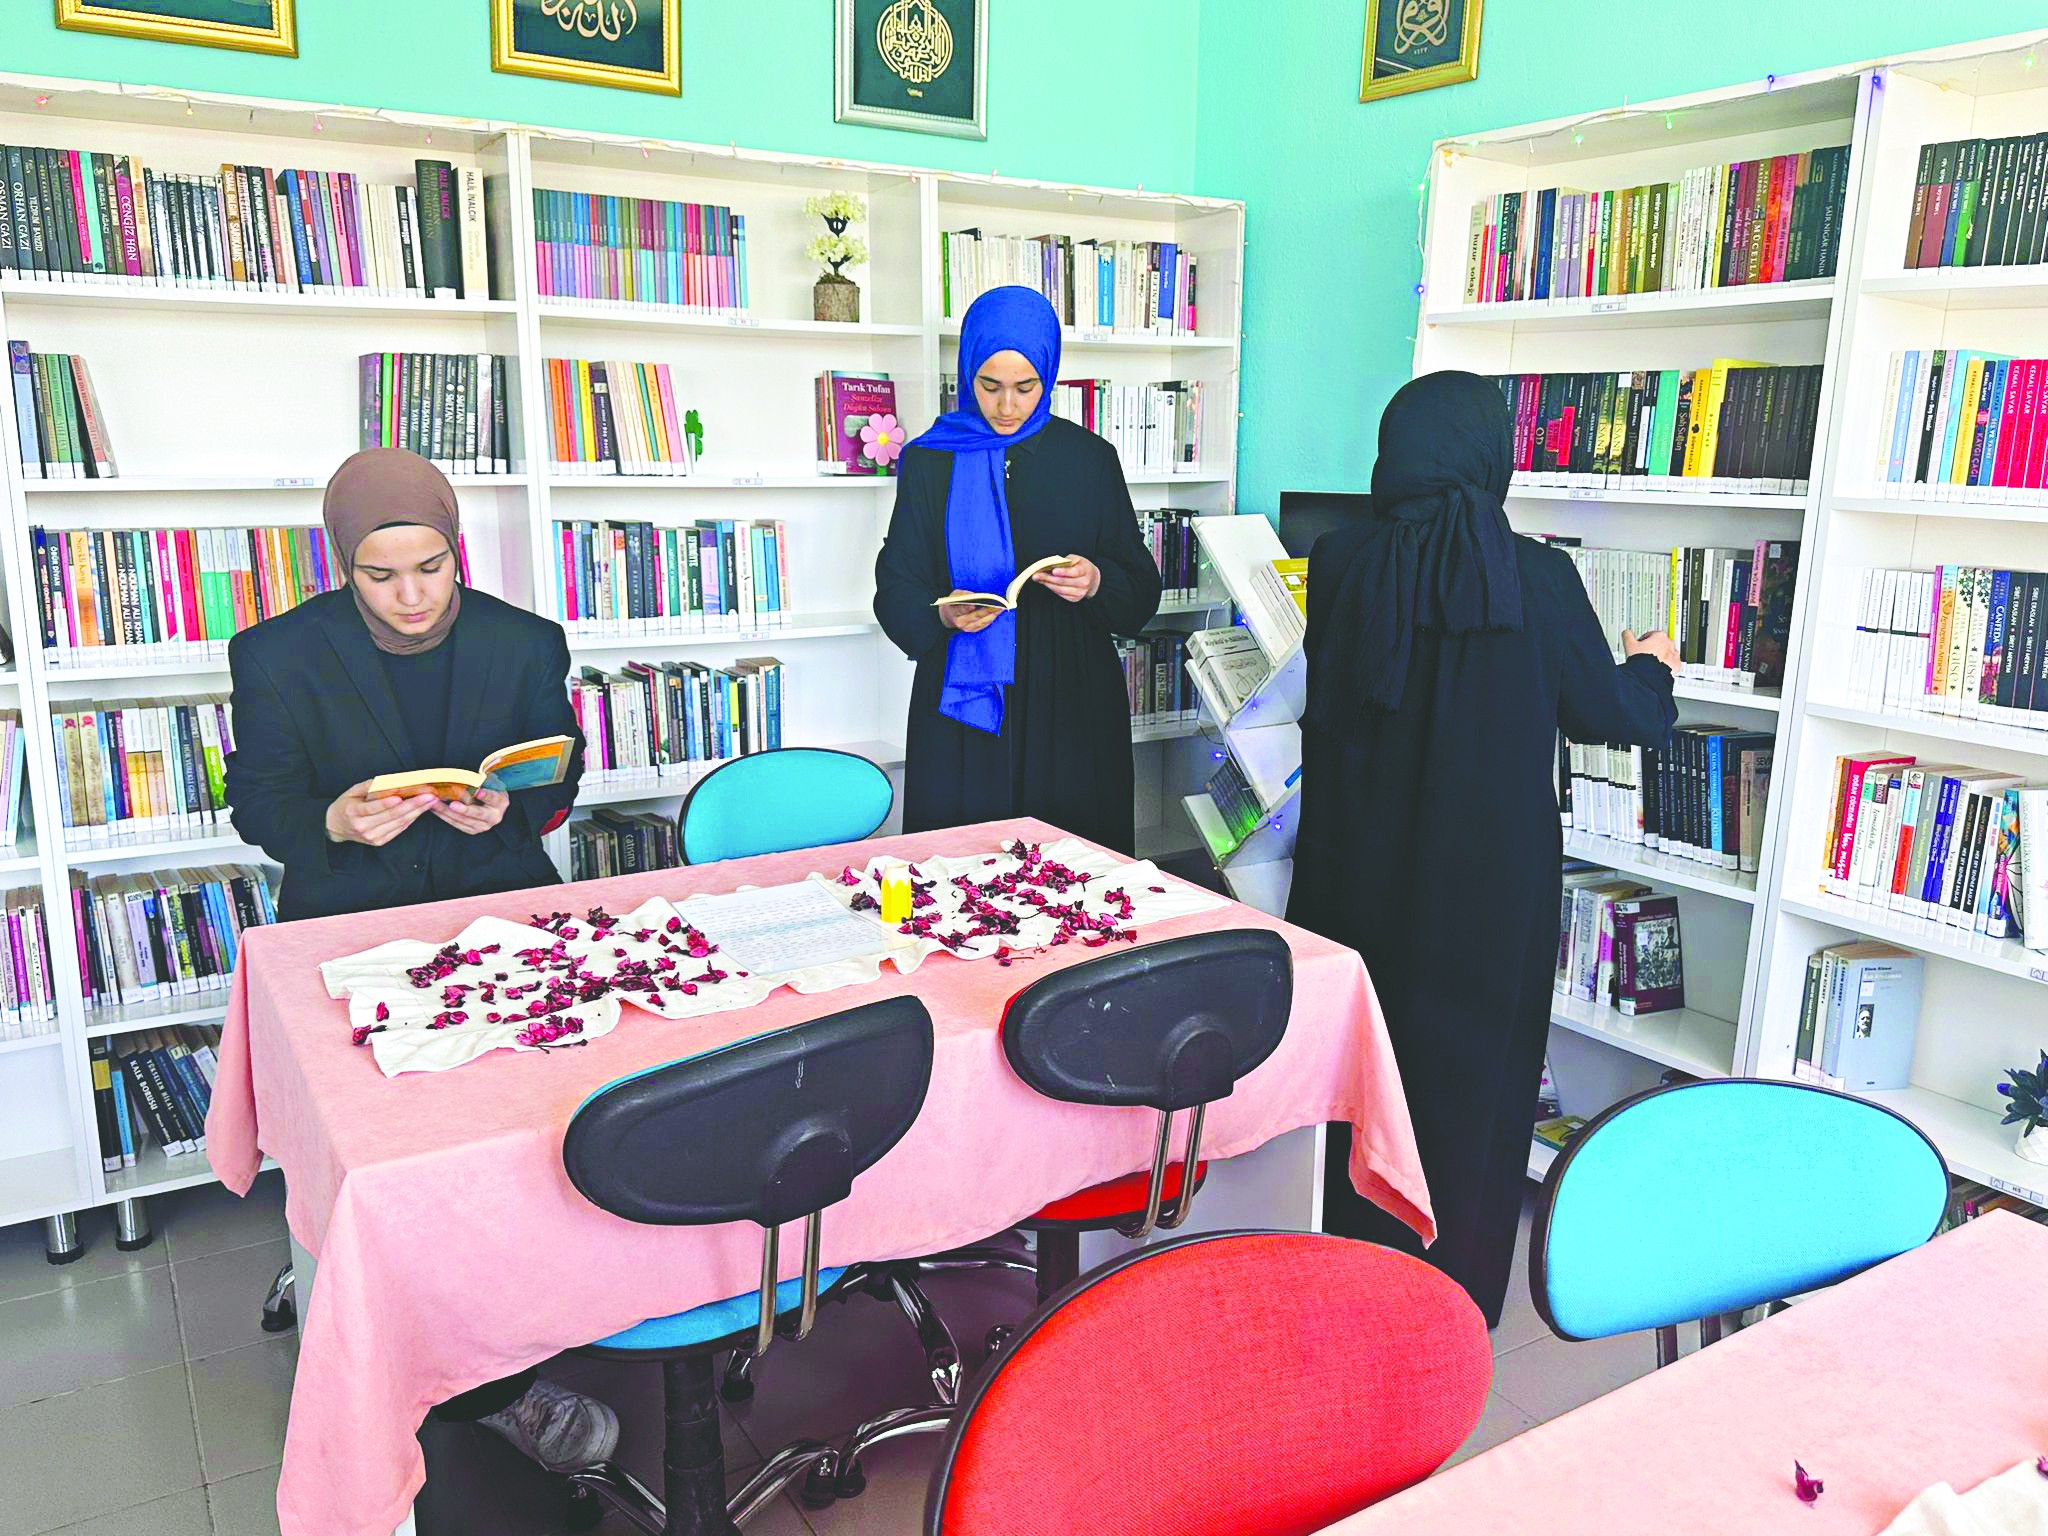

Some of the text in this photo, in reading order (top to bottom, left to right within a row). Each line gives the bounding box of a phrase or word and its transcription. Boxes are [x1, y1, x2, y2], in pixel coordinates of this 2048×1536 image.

[466, 170, 478, 192] HALİL
[12, 182, 30, 250] ORHAN GAZİ
[466, 194, 478, 222] İNALCIK
[120, 196, 138, 262] CENGİZ HAN
[1467, 233, 1480, 297] huzur sokağı
[1817, 249, 1828, 275] HANIM
[842, 382, 890, 394] Tarık Tufan
[1967, 370, 1977, 408] KEMAL SAYAR
[1993, 392, 2001, 411] SAYAR
[2006, 365, 2020, 415] KEMAL SAYAR
[2023, 365, 2037, 415] KEMAL SAYAR
[445, 393, 454, 423] SULTAN
[456, 394, 465, 424] SULTAN
[1536, 427, 1545, 444] OD
[1974, 432, 1984, 456] KAYGI
[1989, 429, 1995, 439] VE
[1970, 458, 1980, 478] ÇAĞI
[53, 566, 61, 586] DİVAN
[117, 568, 128, 606] NOUMAN
[125, 621, 133, 644] KHAN
[128, 568, 139, 606] NOUMAN
[134, 621, 144, 644] KHAN
[2010, 600, 2020, 626] ERASLAN
[2028, 602, 2038, 627] ERASLAN
[1992, 606, 2005, 643] CANFEDA
[2005, 651, 2014, 674] MERYEM
[2022, 653, 2031, 675] MERYEM
[1851, 774, 1860, 794] DOĞAN
[1844, 795, 1858, 828] CÜCELOĞLU
[1841, 832, 1856, 849] Var
[130, 1060, 158, 1111] KALK BORUSU
[147, 1059, 174, 1111] YÜKSELEN HİLAL
